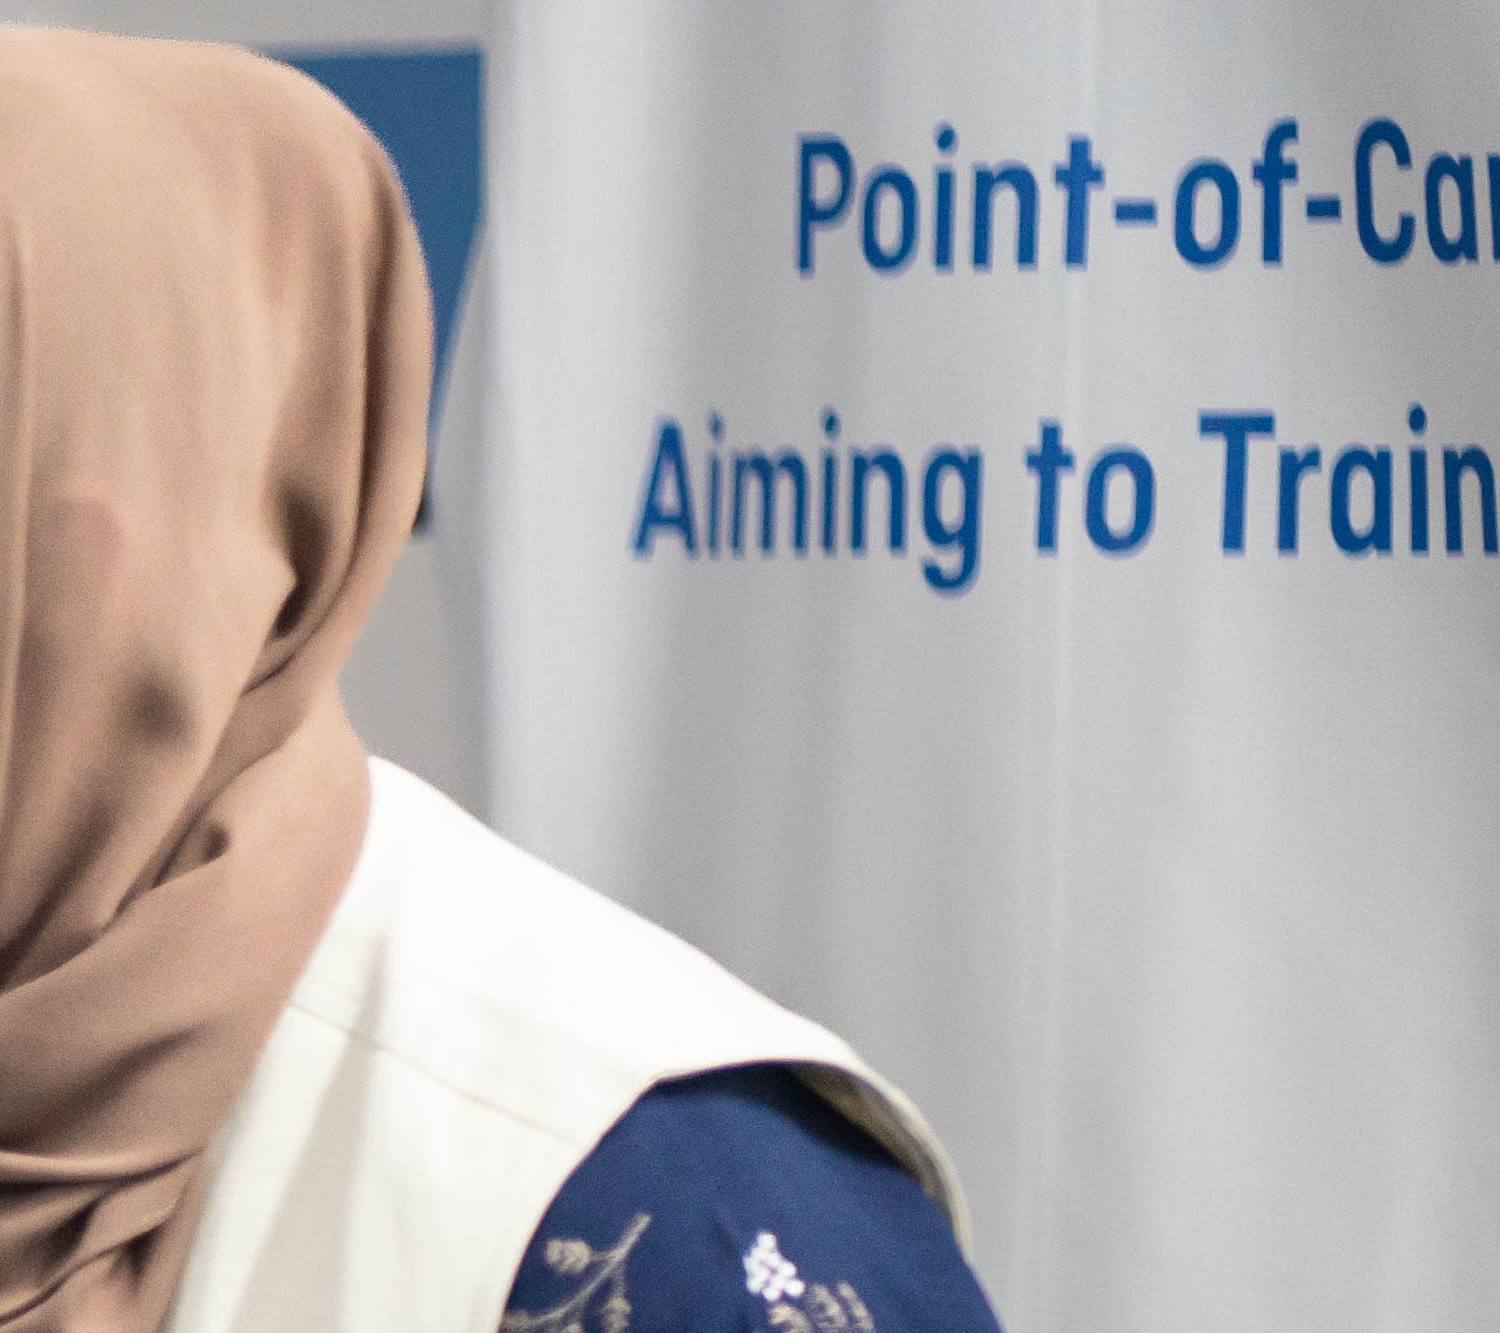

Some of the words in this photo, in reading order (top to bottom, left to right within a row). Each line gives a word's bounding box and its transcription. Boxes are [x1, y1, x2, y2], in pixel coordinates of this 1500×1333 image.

[797, 117, 1500, 276] Point-of-Ca
[632, 405, 983, 595] Aiming
[1025, 418, 1157, 557] to
[1197, 401, 1500, 558] Train
